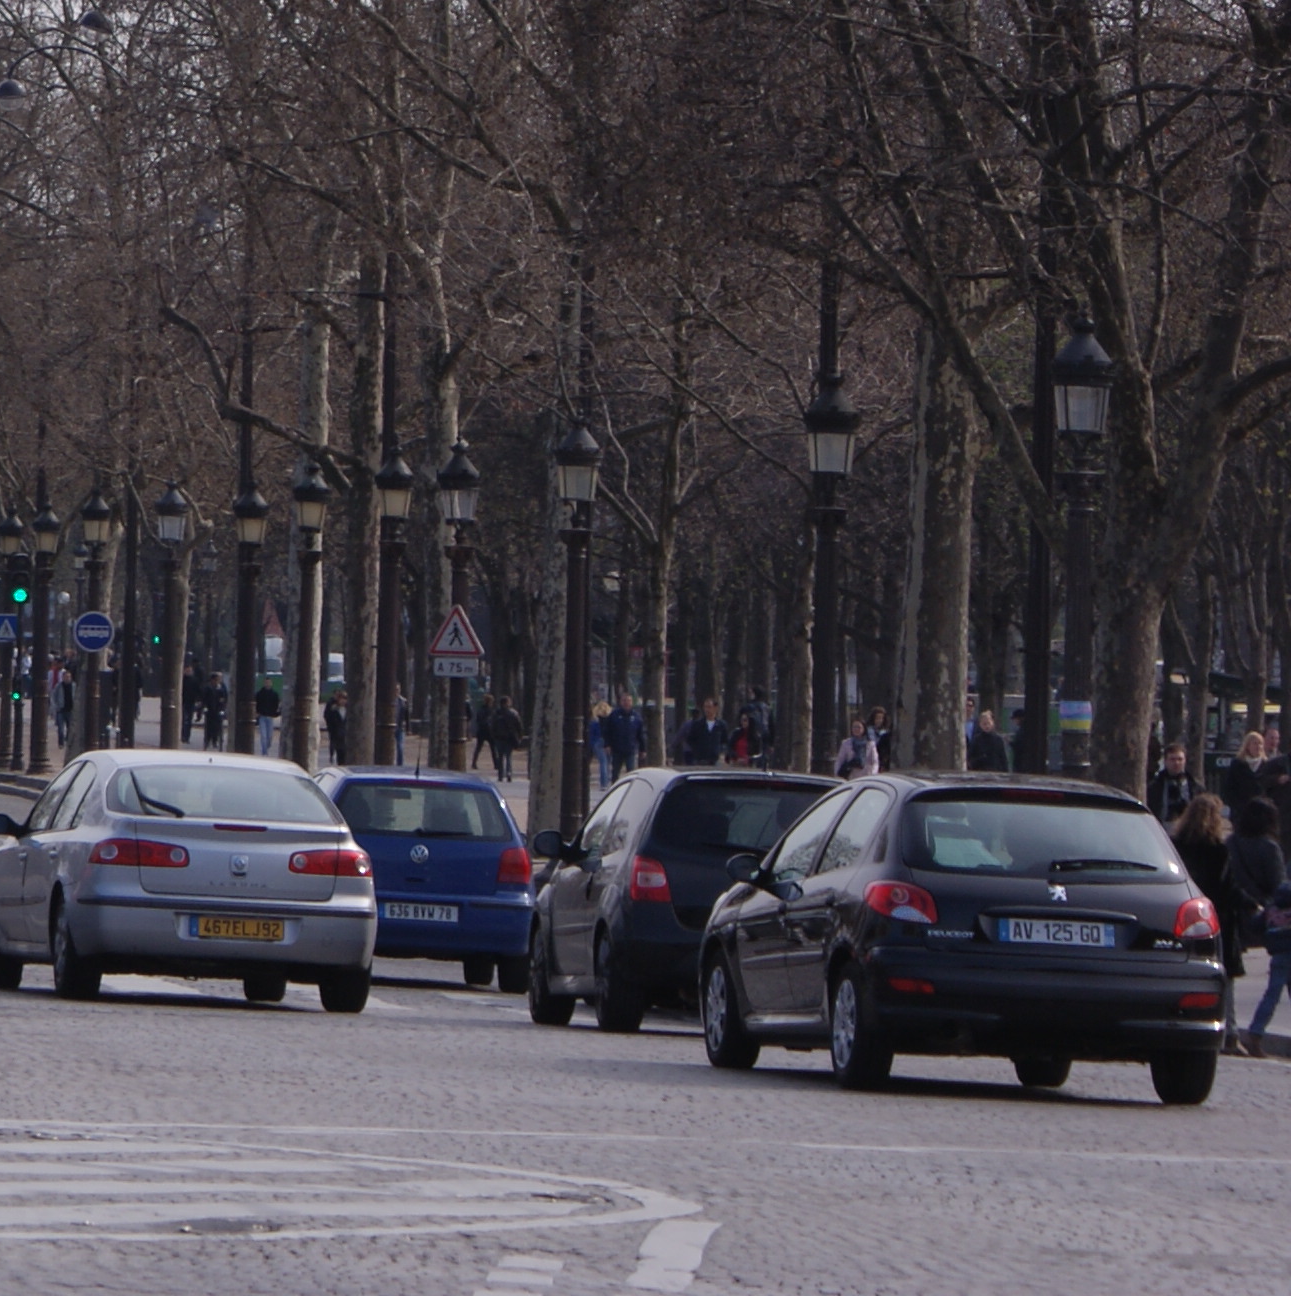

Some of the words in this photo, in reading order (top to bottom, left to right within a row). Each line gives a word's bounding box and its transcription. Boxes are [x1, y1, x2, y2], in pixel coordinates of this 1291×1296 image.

[437, 662, 444, 672] A
[389, 904, 410, 918] 636
[438, 907, 452, 920] 78
[927, 928, 975, 939] PEUGEOT
[1012, 921, 1102, 944] AV-125-GQ
